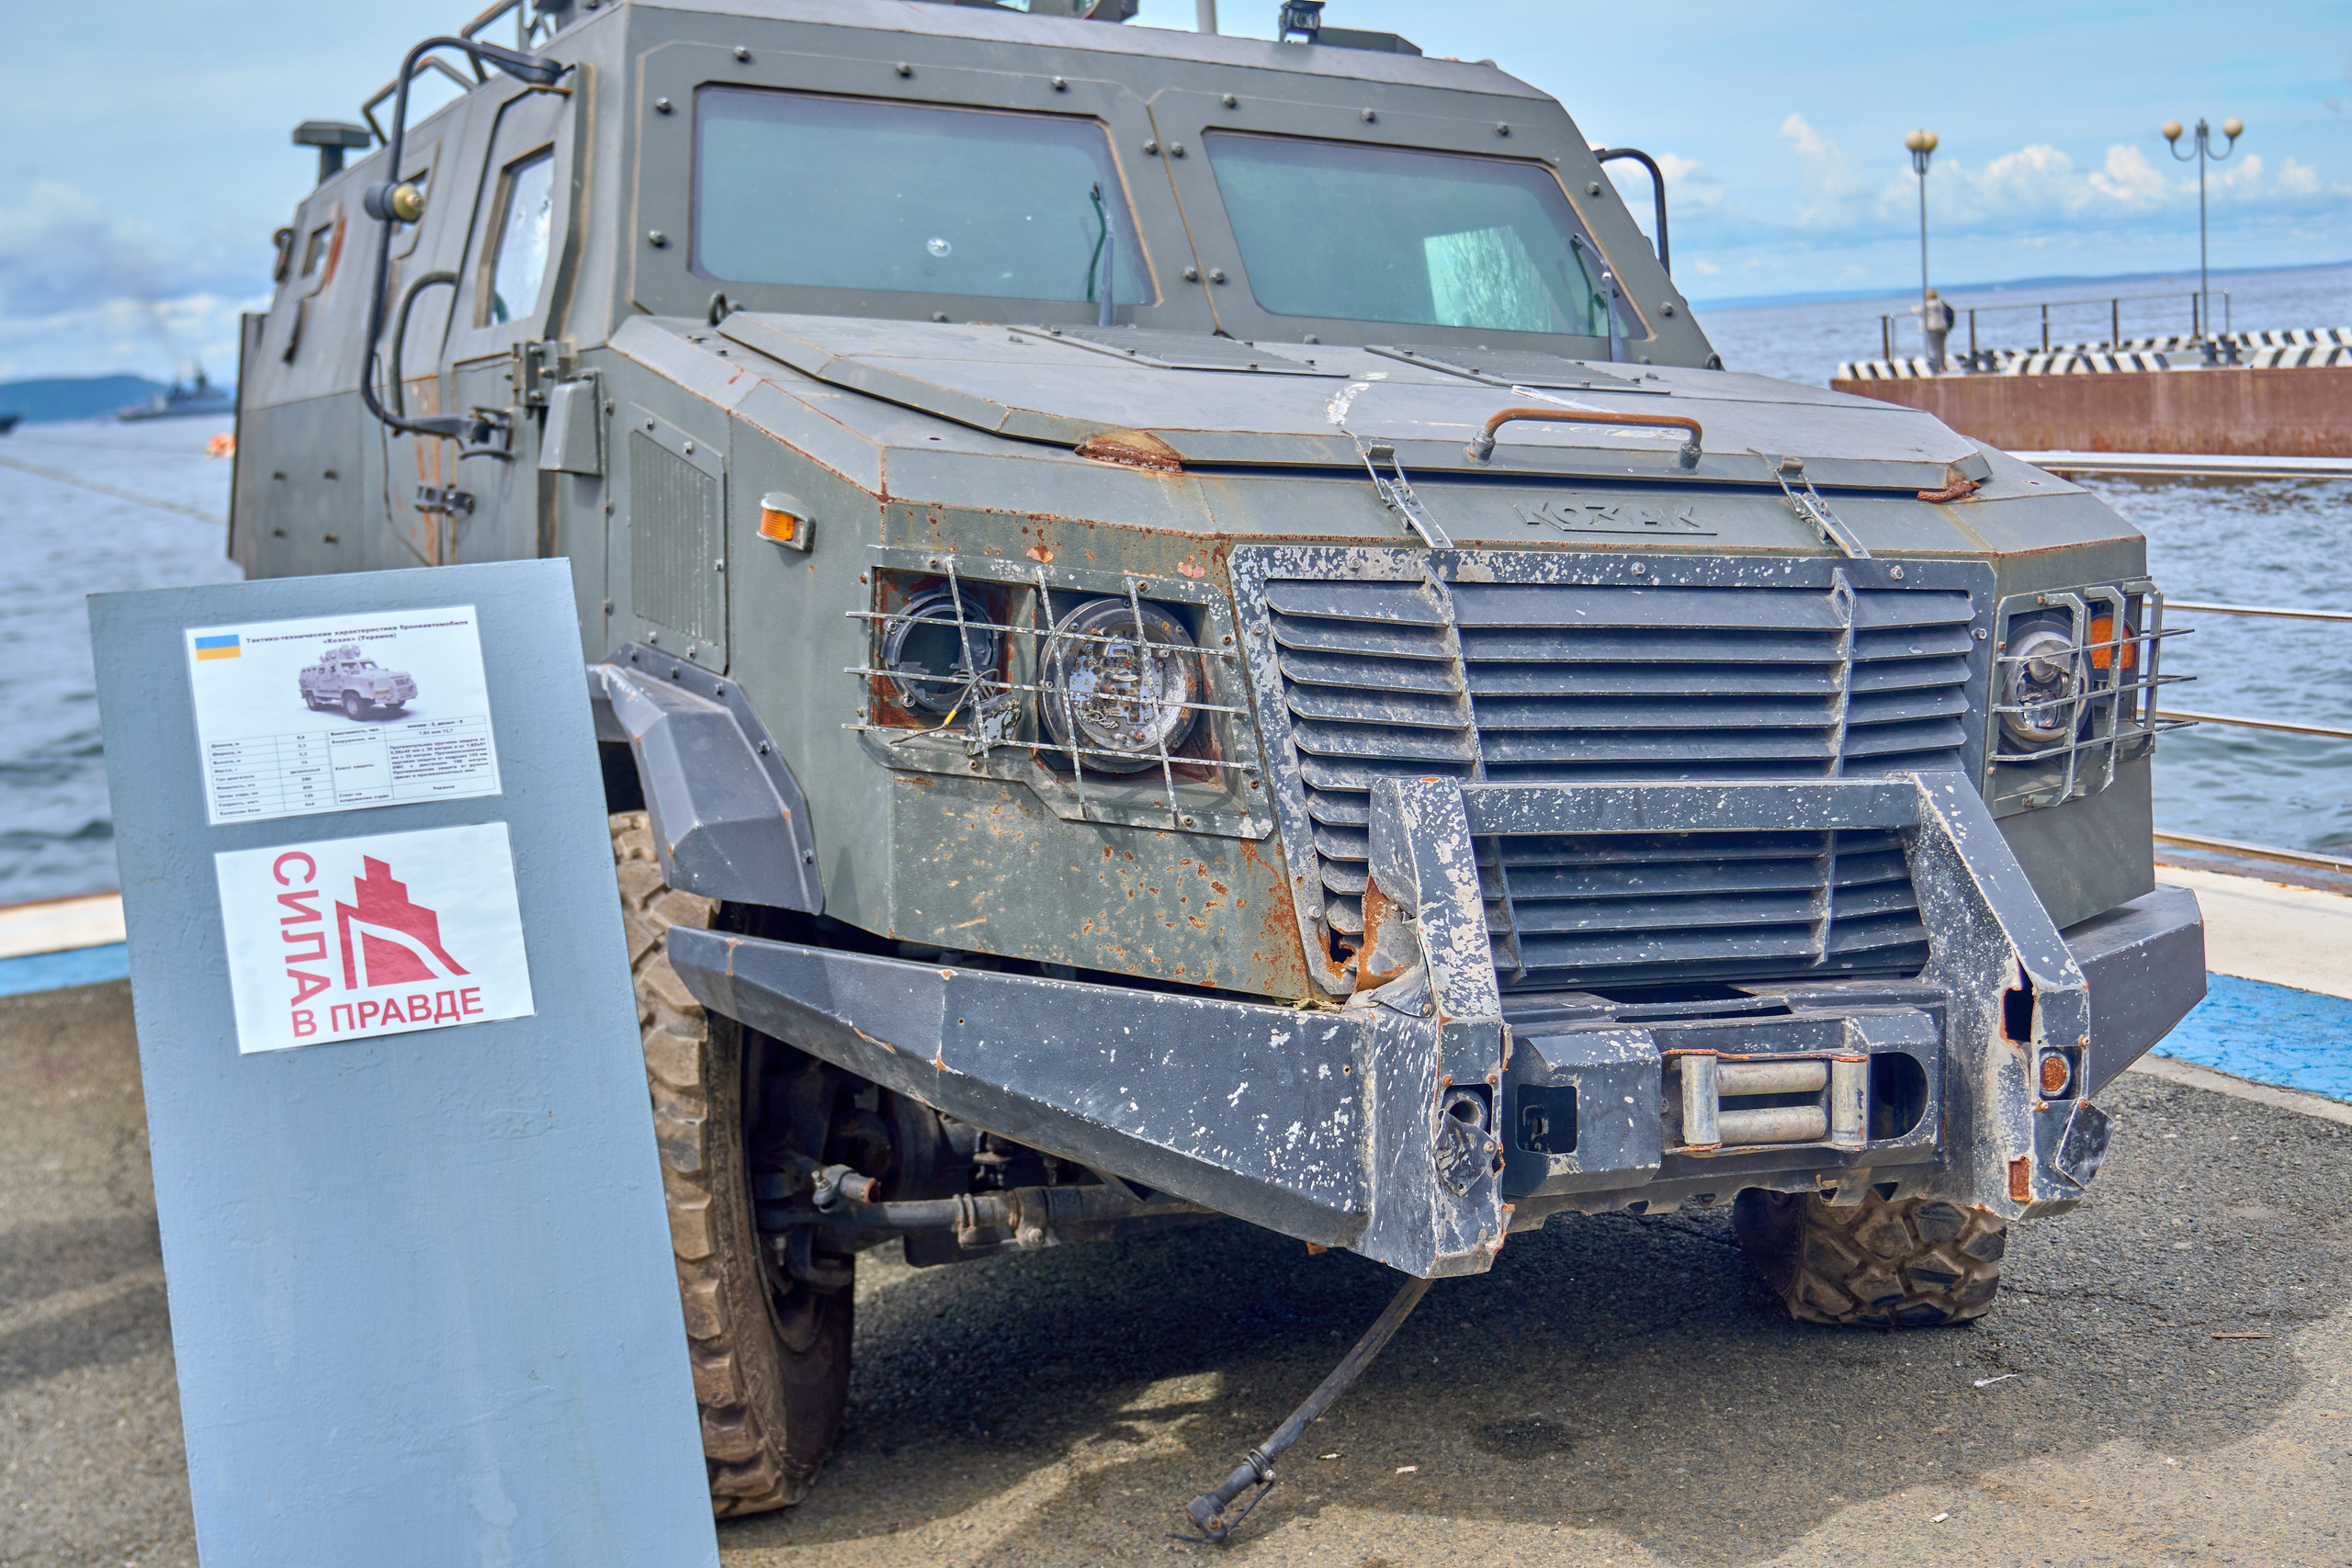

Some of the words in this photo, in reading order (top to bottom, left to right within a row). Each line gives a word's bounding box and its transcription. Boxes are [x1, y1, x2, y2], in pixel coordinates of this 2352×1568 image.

[246, 632, 332, 643] Тактико-технические
[334, 626, 398, 636] характеристики
[400, 621, 469, 631] бронеавтомобиля
[357, 633, 397, 641] (Украина)
[274, 852, 331, 1006] СИЛА
[292, 1010, 316, 1037] В
[331, 987, 483, 1032] ПРАВДЕ
